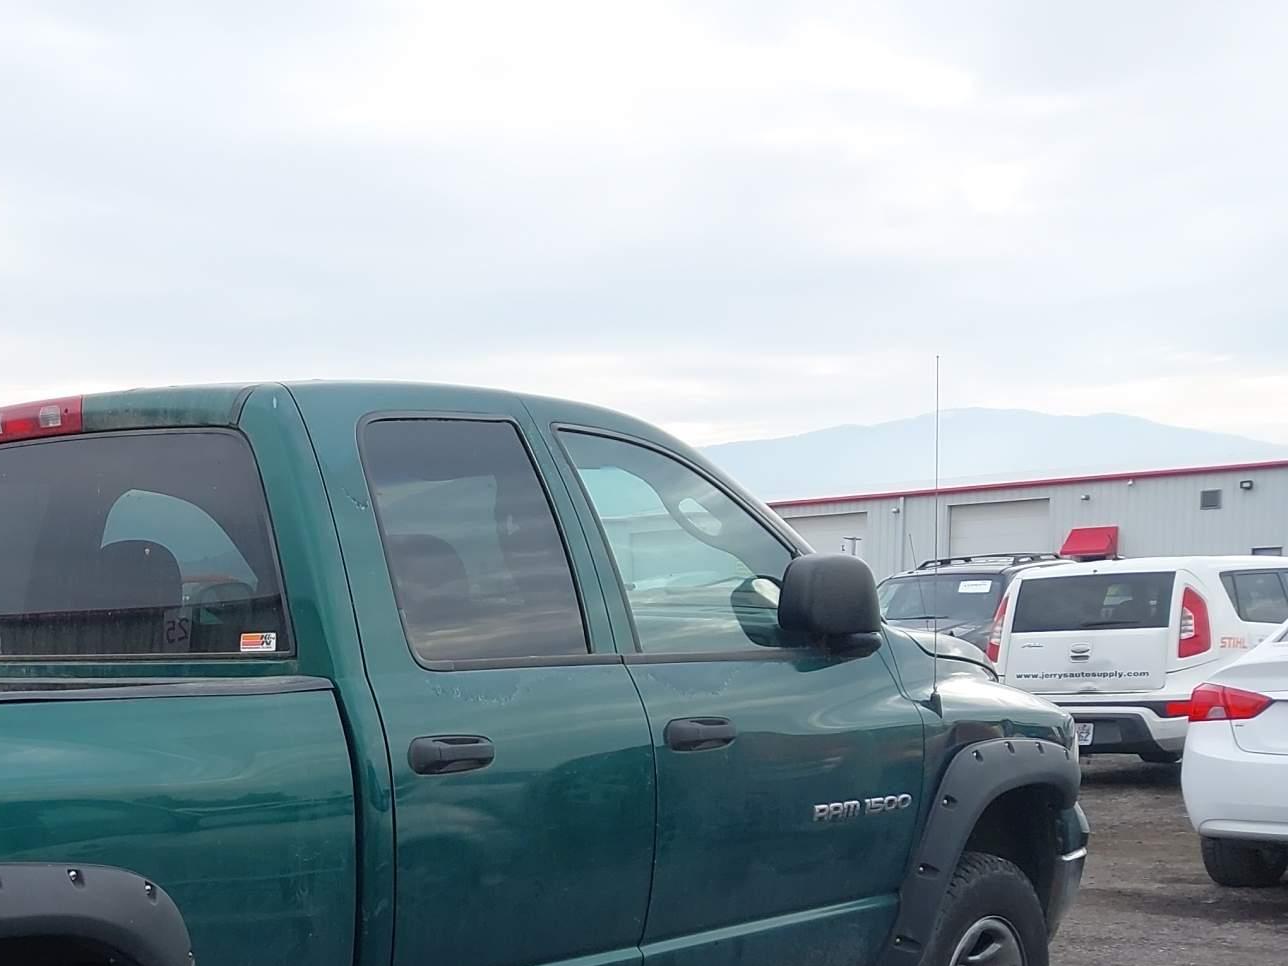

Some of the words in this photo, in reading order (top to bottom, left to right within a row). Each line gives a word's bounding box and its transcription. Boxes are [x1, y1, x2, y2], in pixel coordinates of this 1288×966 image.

[1219, 635, 1249, 649] STIHL
[1015, 670, 1150, 681] www.jerrysautosupply.com
[813, 800, 861, 822] RAM
[864, 793, 912, 815] 1500
